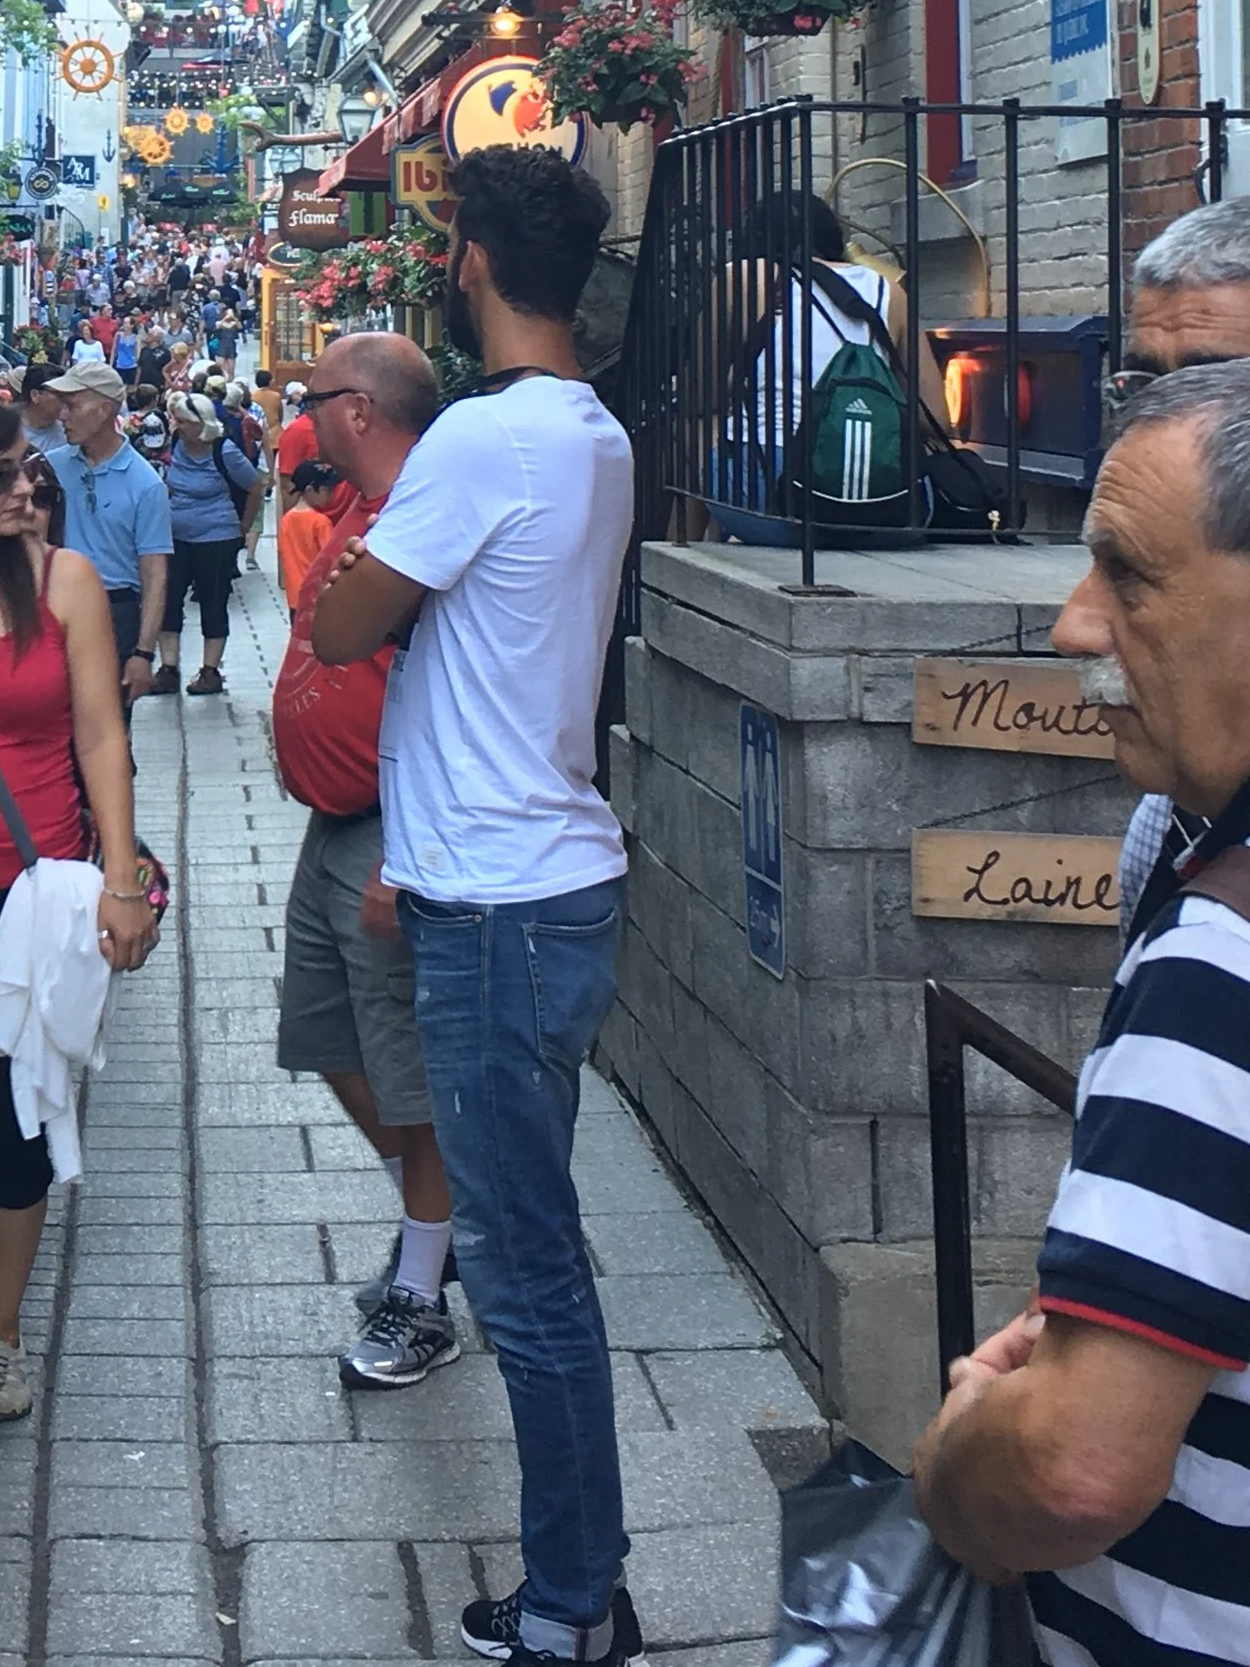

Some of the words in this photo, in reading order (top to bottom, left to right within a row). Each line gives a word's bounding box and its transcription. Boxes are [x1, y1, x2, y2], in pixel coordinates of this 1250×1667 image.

[402, 160, 448, 193] Ibi
[940, 678, 1117, 736] Mouto
[962, 850, 1121, 912] Laine
